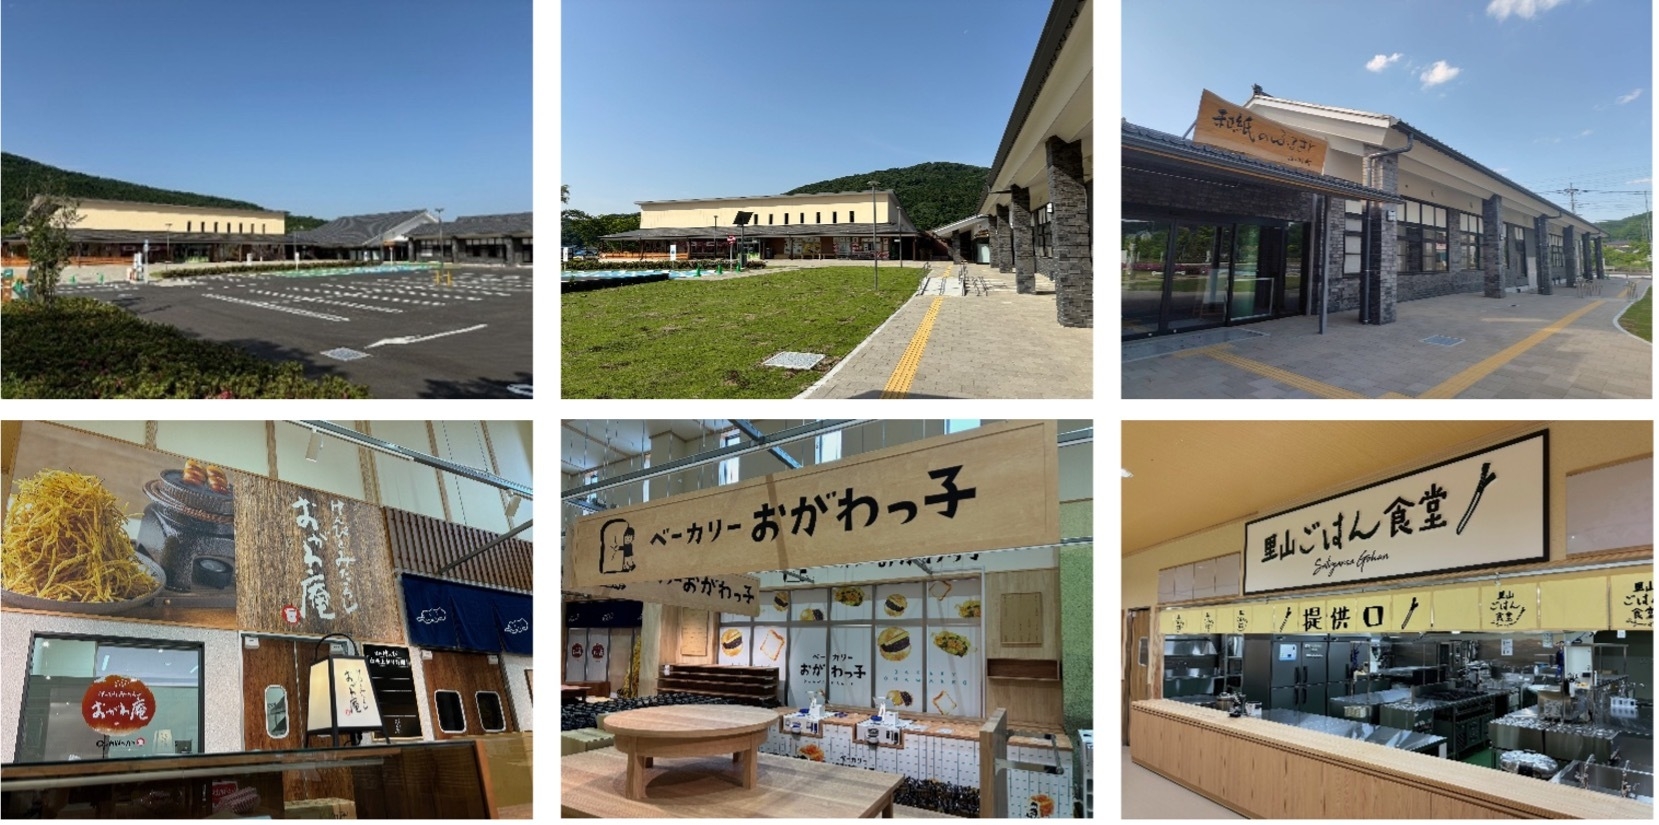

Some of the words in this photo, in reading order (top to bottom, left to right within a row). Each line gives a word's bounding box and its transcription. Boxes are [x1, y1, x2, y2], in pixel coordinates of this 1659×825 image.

[650, 518, 741, 545] ベーカリー
[751, 464, 977, 542] おがわっ子
[1261, 483, 1448, 563] 里山ごはん食堂
[291, 495, 336, 620] おがわ庵
[1356, 550, 1390, 572] Gohan
[1490, 601, 1520, 611] ごはん
[1497, 591, 1514, 600] 里山
[1624, 594, 1653, 605] ごは
[1302, 605, 1384, 631] 提供口
[1495, 611, 1514, 622] 食堂
[800, 662, 866, 679] おがわっ子
[91, 697, 149, 720] おがわ庵
